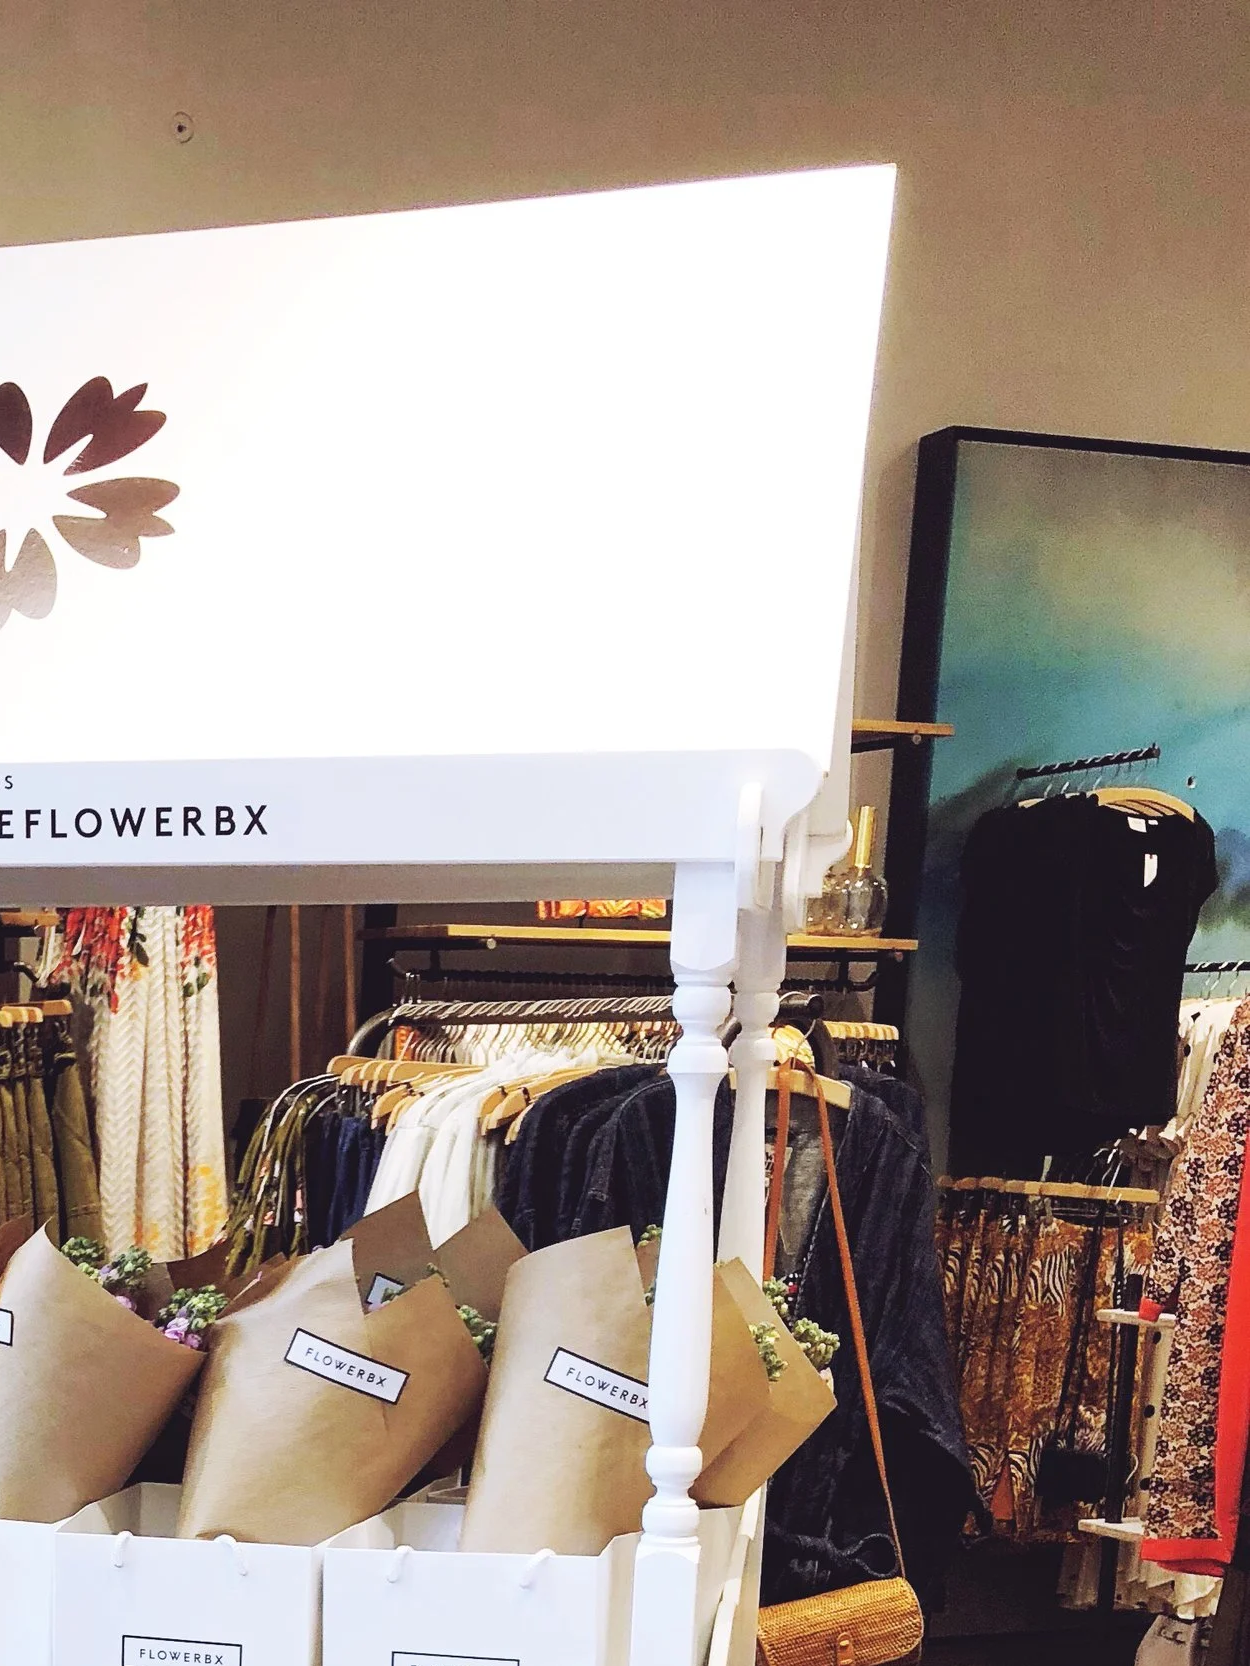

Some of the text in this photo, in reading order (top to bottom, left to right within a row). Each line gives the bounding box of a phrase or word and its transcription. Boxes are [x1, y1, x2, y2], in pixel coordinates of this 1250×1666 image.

[305, 1347, 387, 1388] FLOWERBX
[565, 1367, 649, 1410] FLOWERBX
[139, 1647, 224, 1666] FLOWERBX
